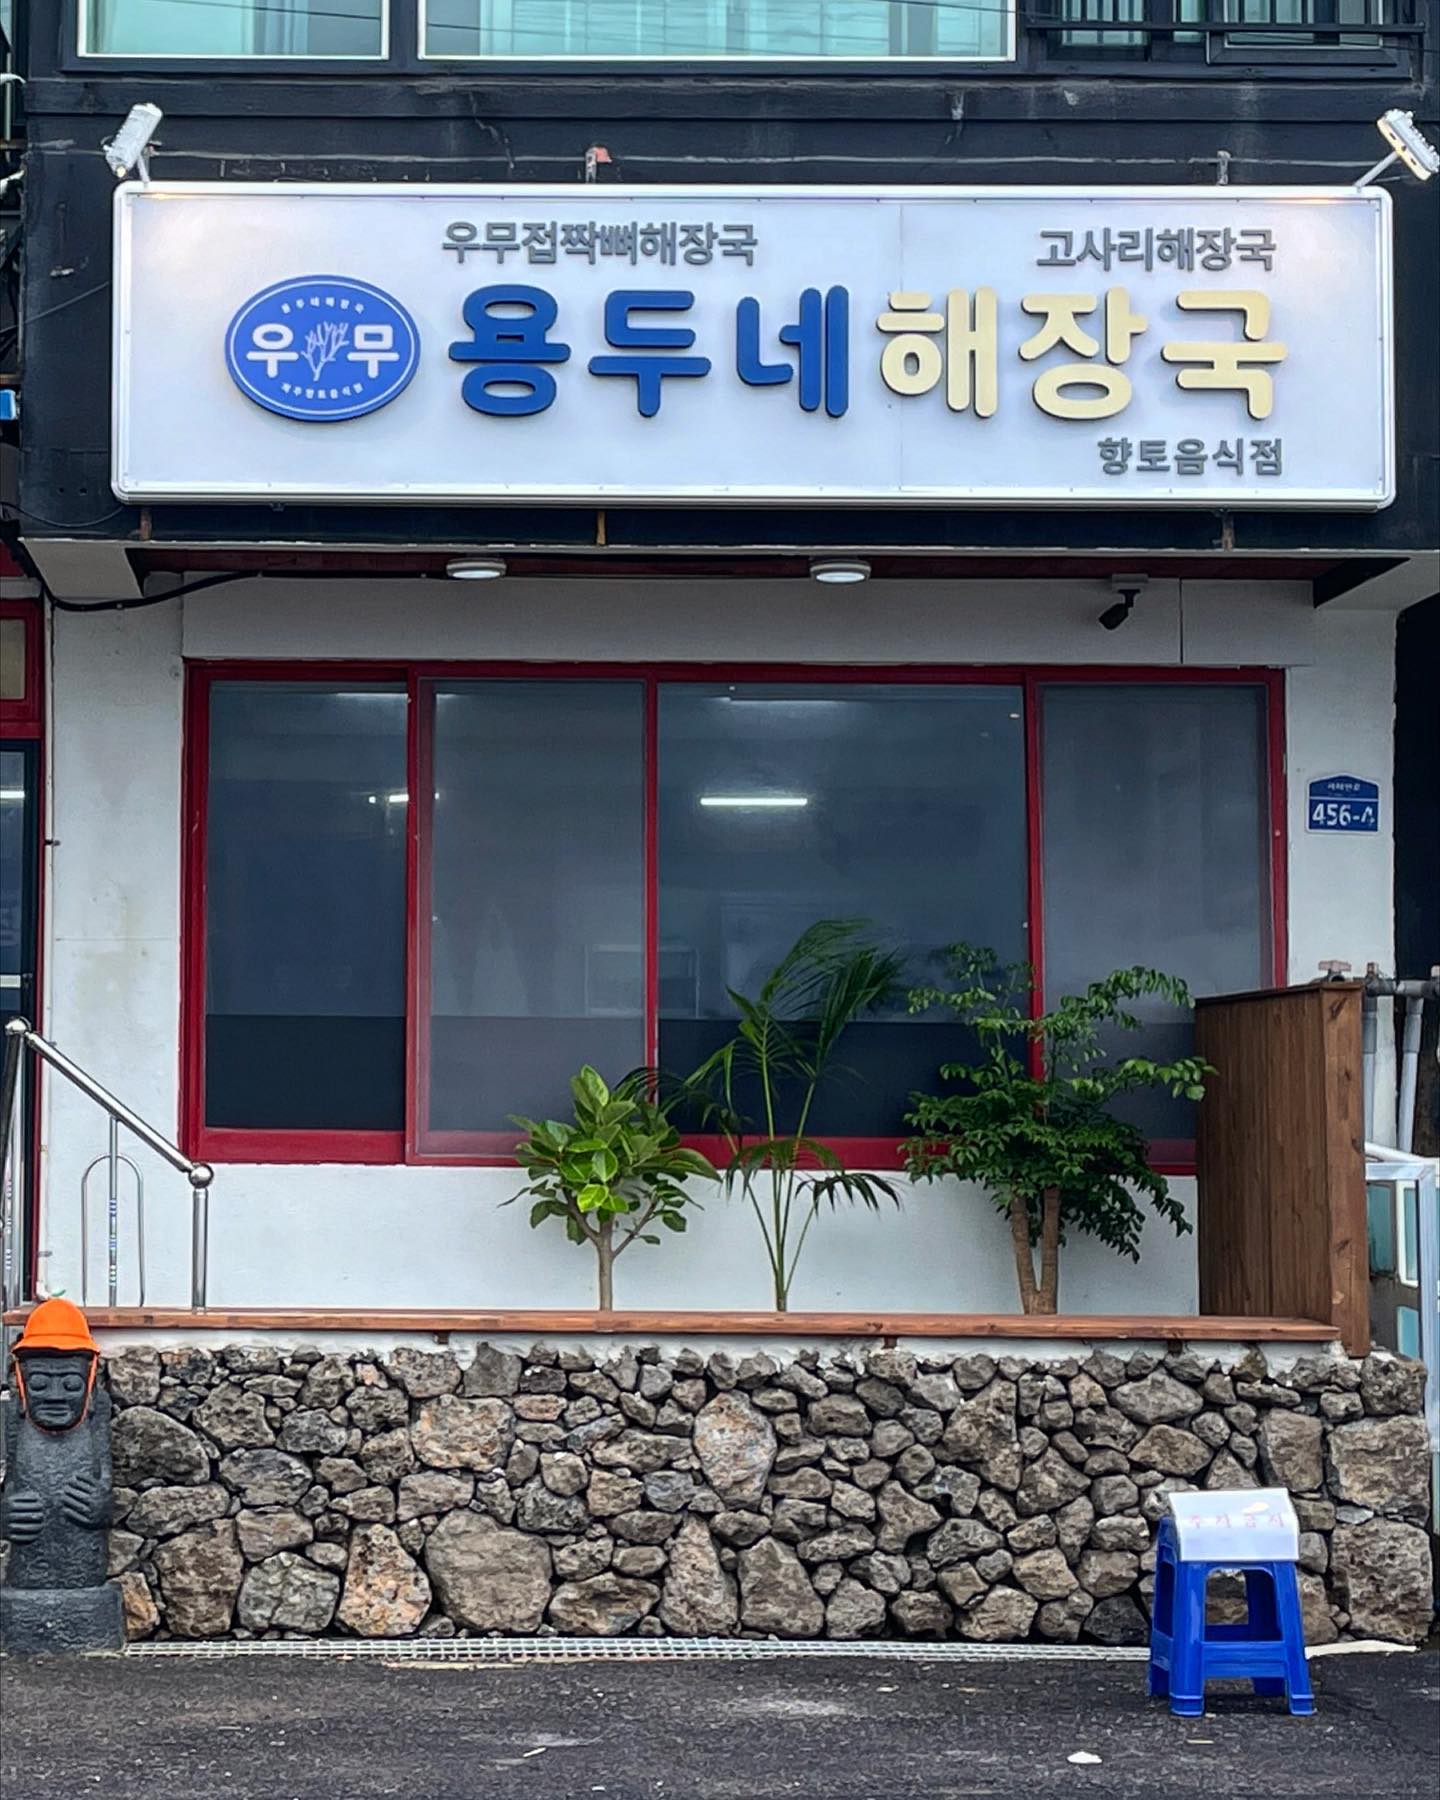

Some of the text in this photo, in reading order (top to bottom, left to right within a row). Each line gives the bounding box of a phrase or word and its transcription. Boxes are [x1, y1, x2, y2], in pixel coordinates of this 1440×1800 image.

[443, 221, 758, 266] 우무접짝뼈해장국
[1037, 227, 1277, 272] 고사리해장국
[449, 284, 1288, 421] 용두네해장국
[1098, 438, 1283, 476] 향토음식점
